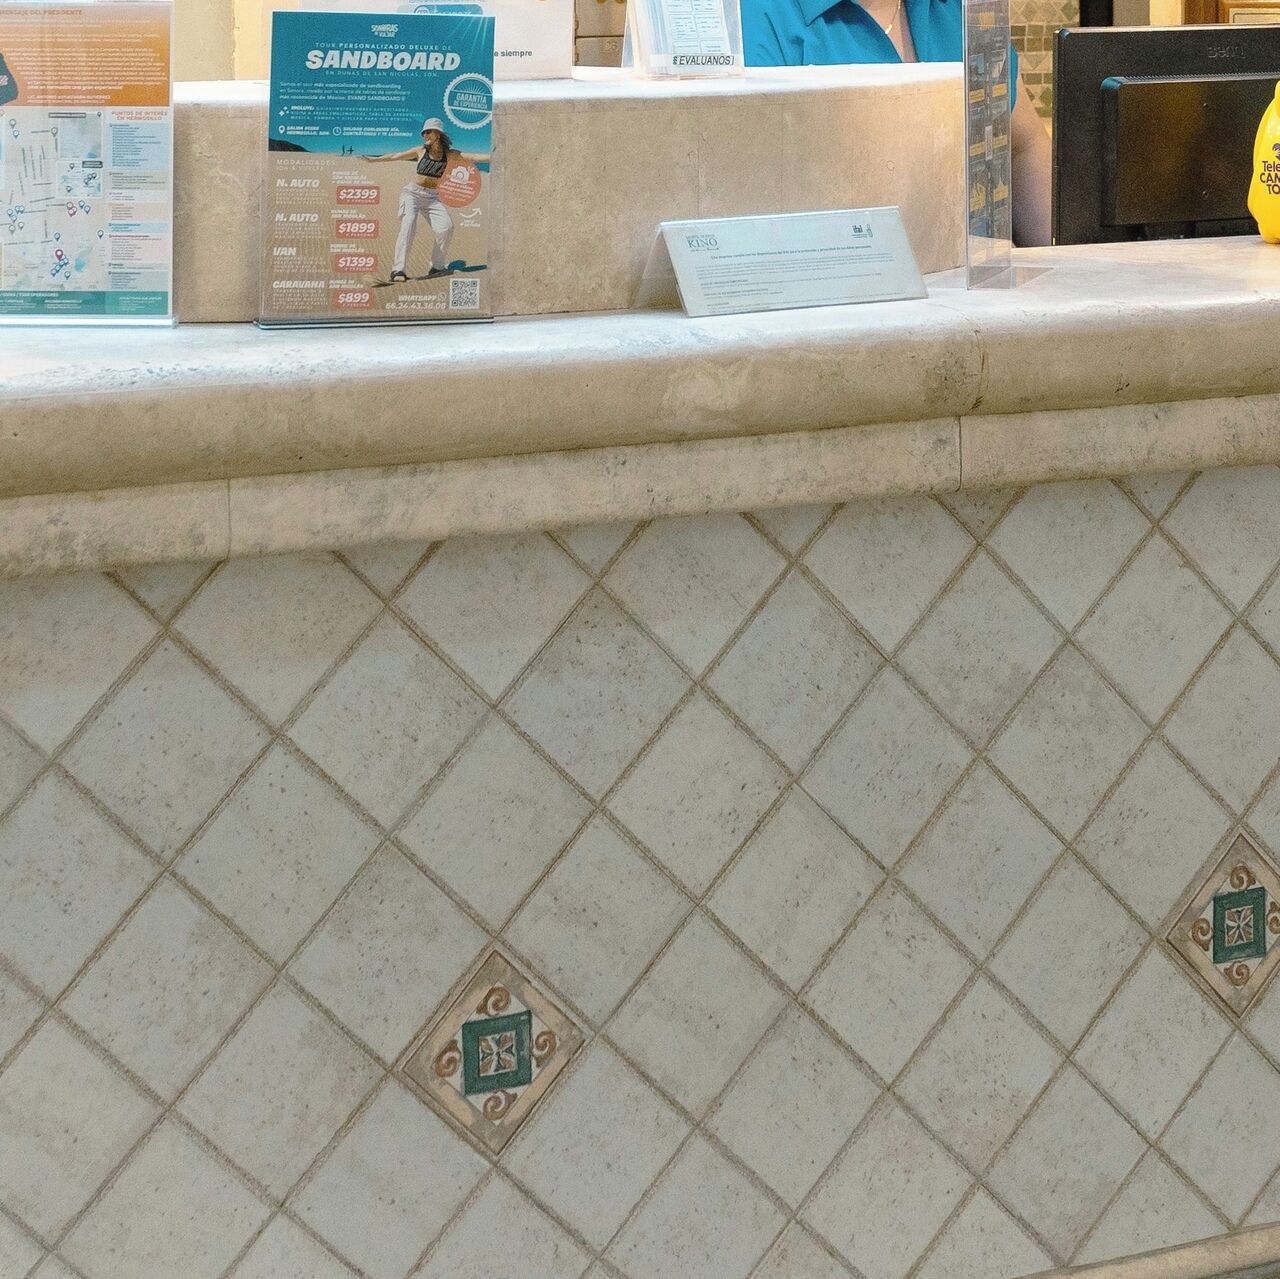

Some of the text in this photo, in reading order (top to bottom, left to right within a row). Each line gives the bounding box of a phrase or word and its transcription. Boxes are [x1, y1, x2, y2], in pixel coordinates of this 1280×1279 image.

[338, 42, 405, 50] PERSONALIZADO
[305, 49, 460, 70] SANDBOARD
[289, 178, 320, 187] AUTO
[339, 188, 377, 199] $2399
[288, 213, 319, 222] AUTO
[338, 222, 375, 233] $1899
[688, 239, 718, 249] KINO
[273, 247, 296, 256] VAN
[338, 256, 374, 267] $1399
[272, 280, 325, 288] CARAVANA
[337, 292, 369, 303] $899
